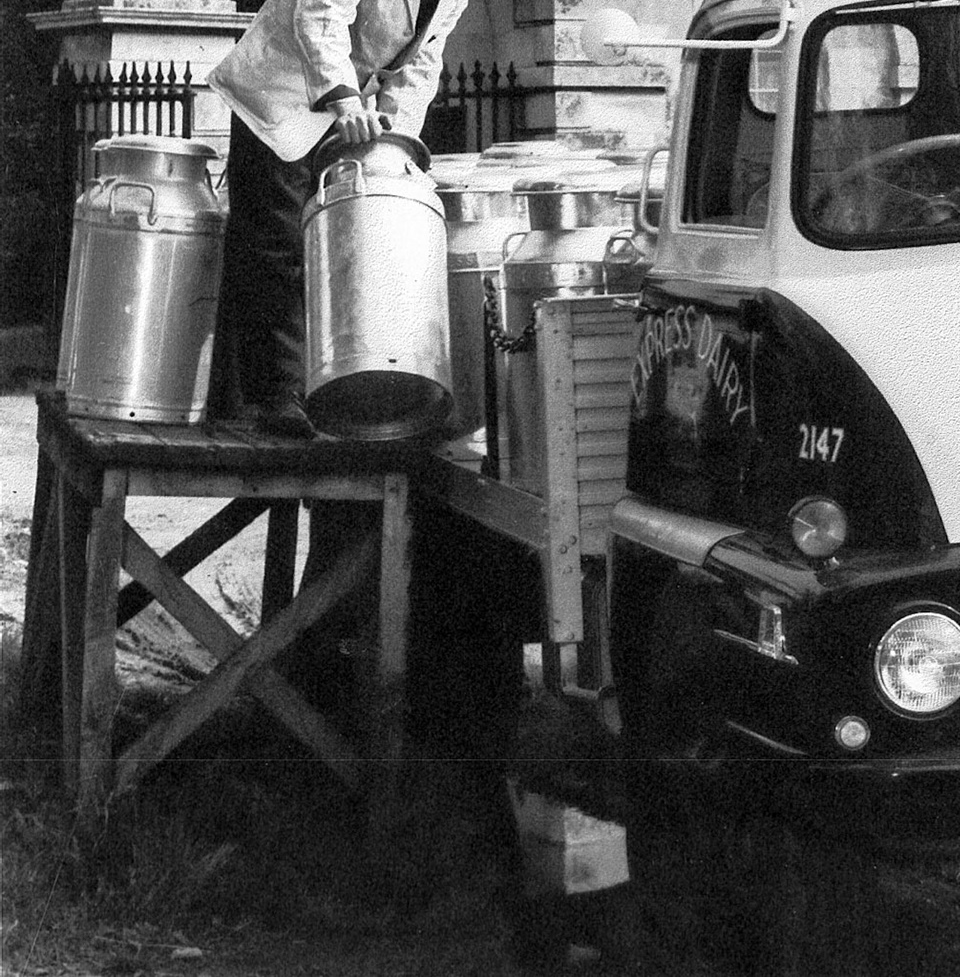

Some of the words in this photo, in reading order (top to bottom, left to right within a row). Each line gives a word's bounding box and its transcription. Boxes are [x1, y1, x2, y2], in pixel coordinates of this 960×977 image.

[630, 305, 696, 419] EXPRESS
[698, 313, 748, 425] DAIRY
[798, 423, 845, 463] 2147
